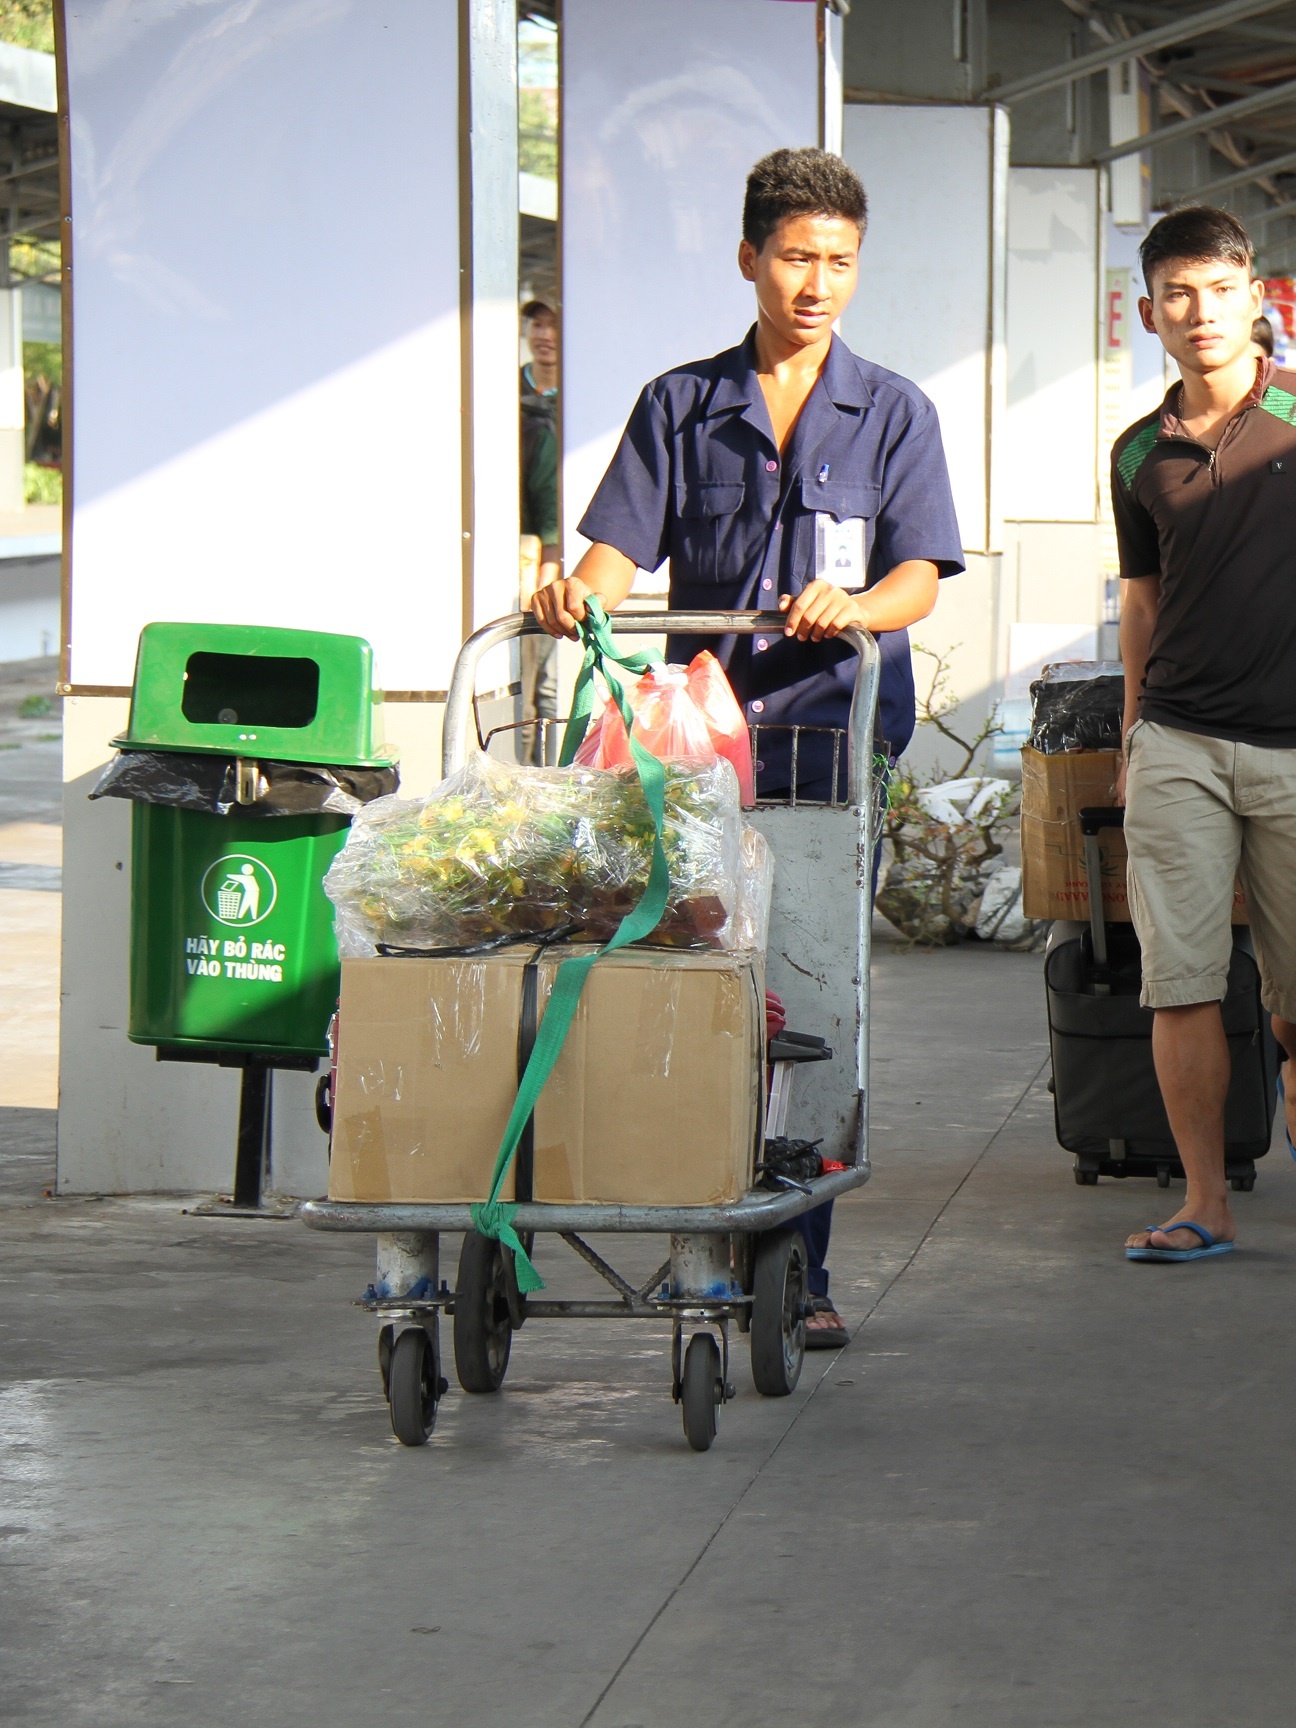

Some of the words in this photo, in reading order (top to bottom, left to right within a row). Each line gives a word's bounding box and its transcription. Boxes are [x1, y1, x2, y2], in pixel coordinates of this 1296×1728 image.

[186, 935, 220, 955] HÃY
[223, 935, 247, 958] BỎ
[251, 939, 286, 961] RÁC
[186, 955, 221, 977] VÀO
[224, 959, 283, 982] THÙNG
